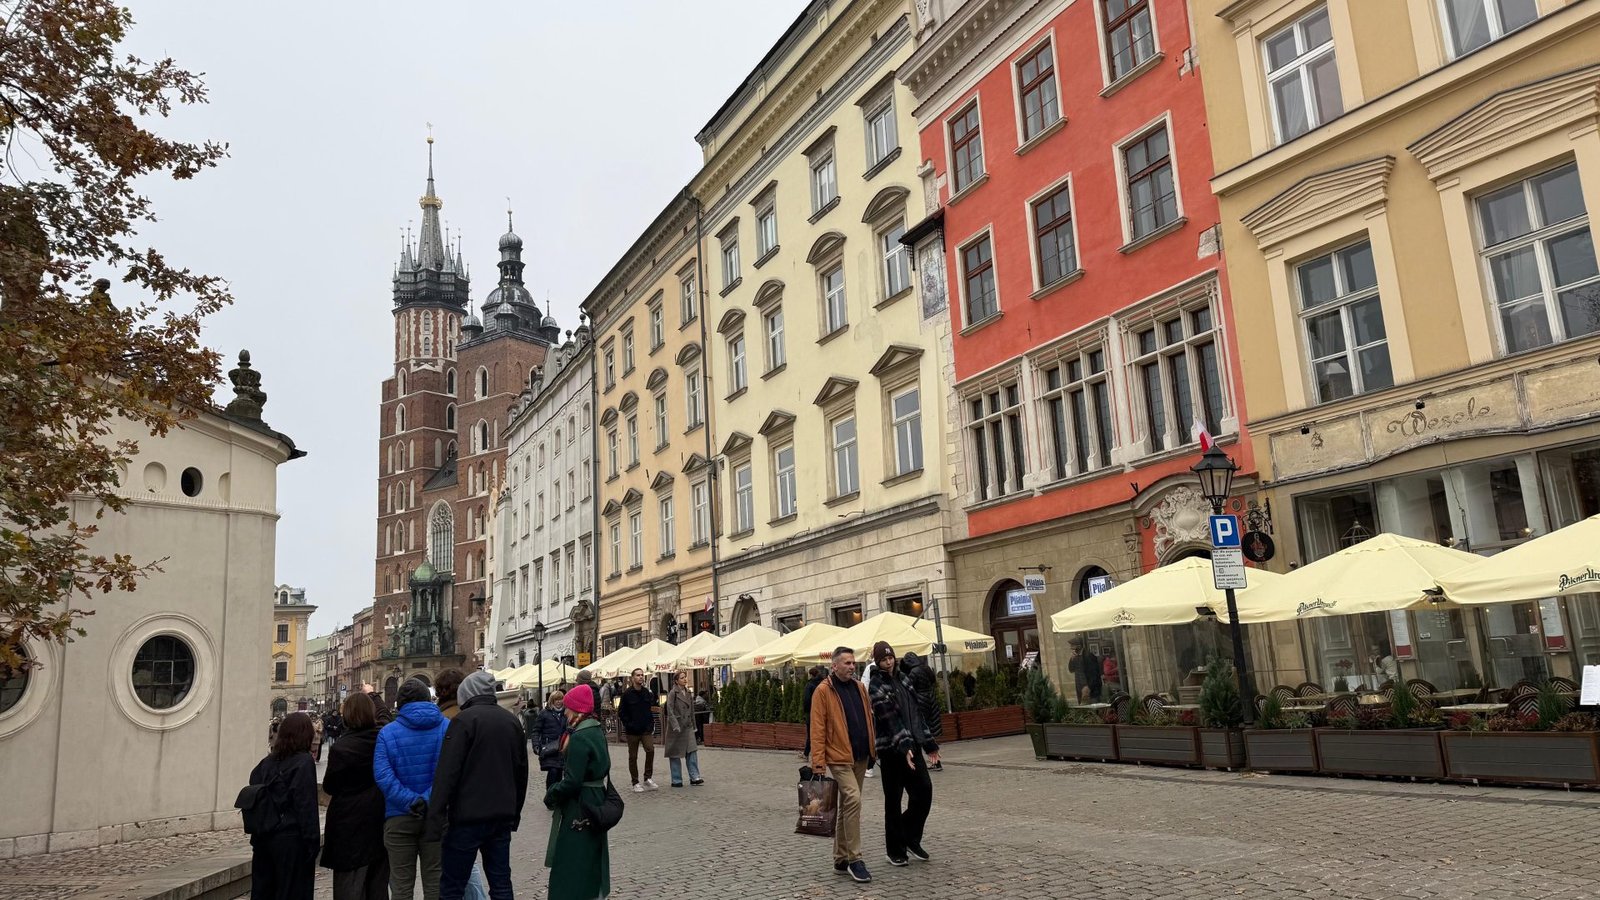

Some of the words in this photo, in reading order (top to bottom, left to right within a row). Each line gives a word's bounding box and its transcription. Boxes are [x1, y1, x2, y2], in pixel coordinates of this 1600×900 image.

[1386, 397, 1491, 437] Wesele
[1215, 518, 1233, 543] P
[964, 641, 988, 650] Pijalnia
